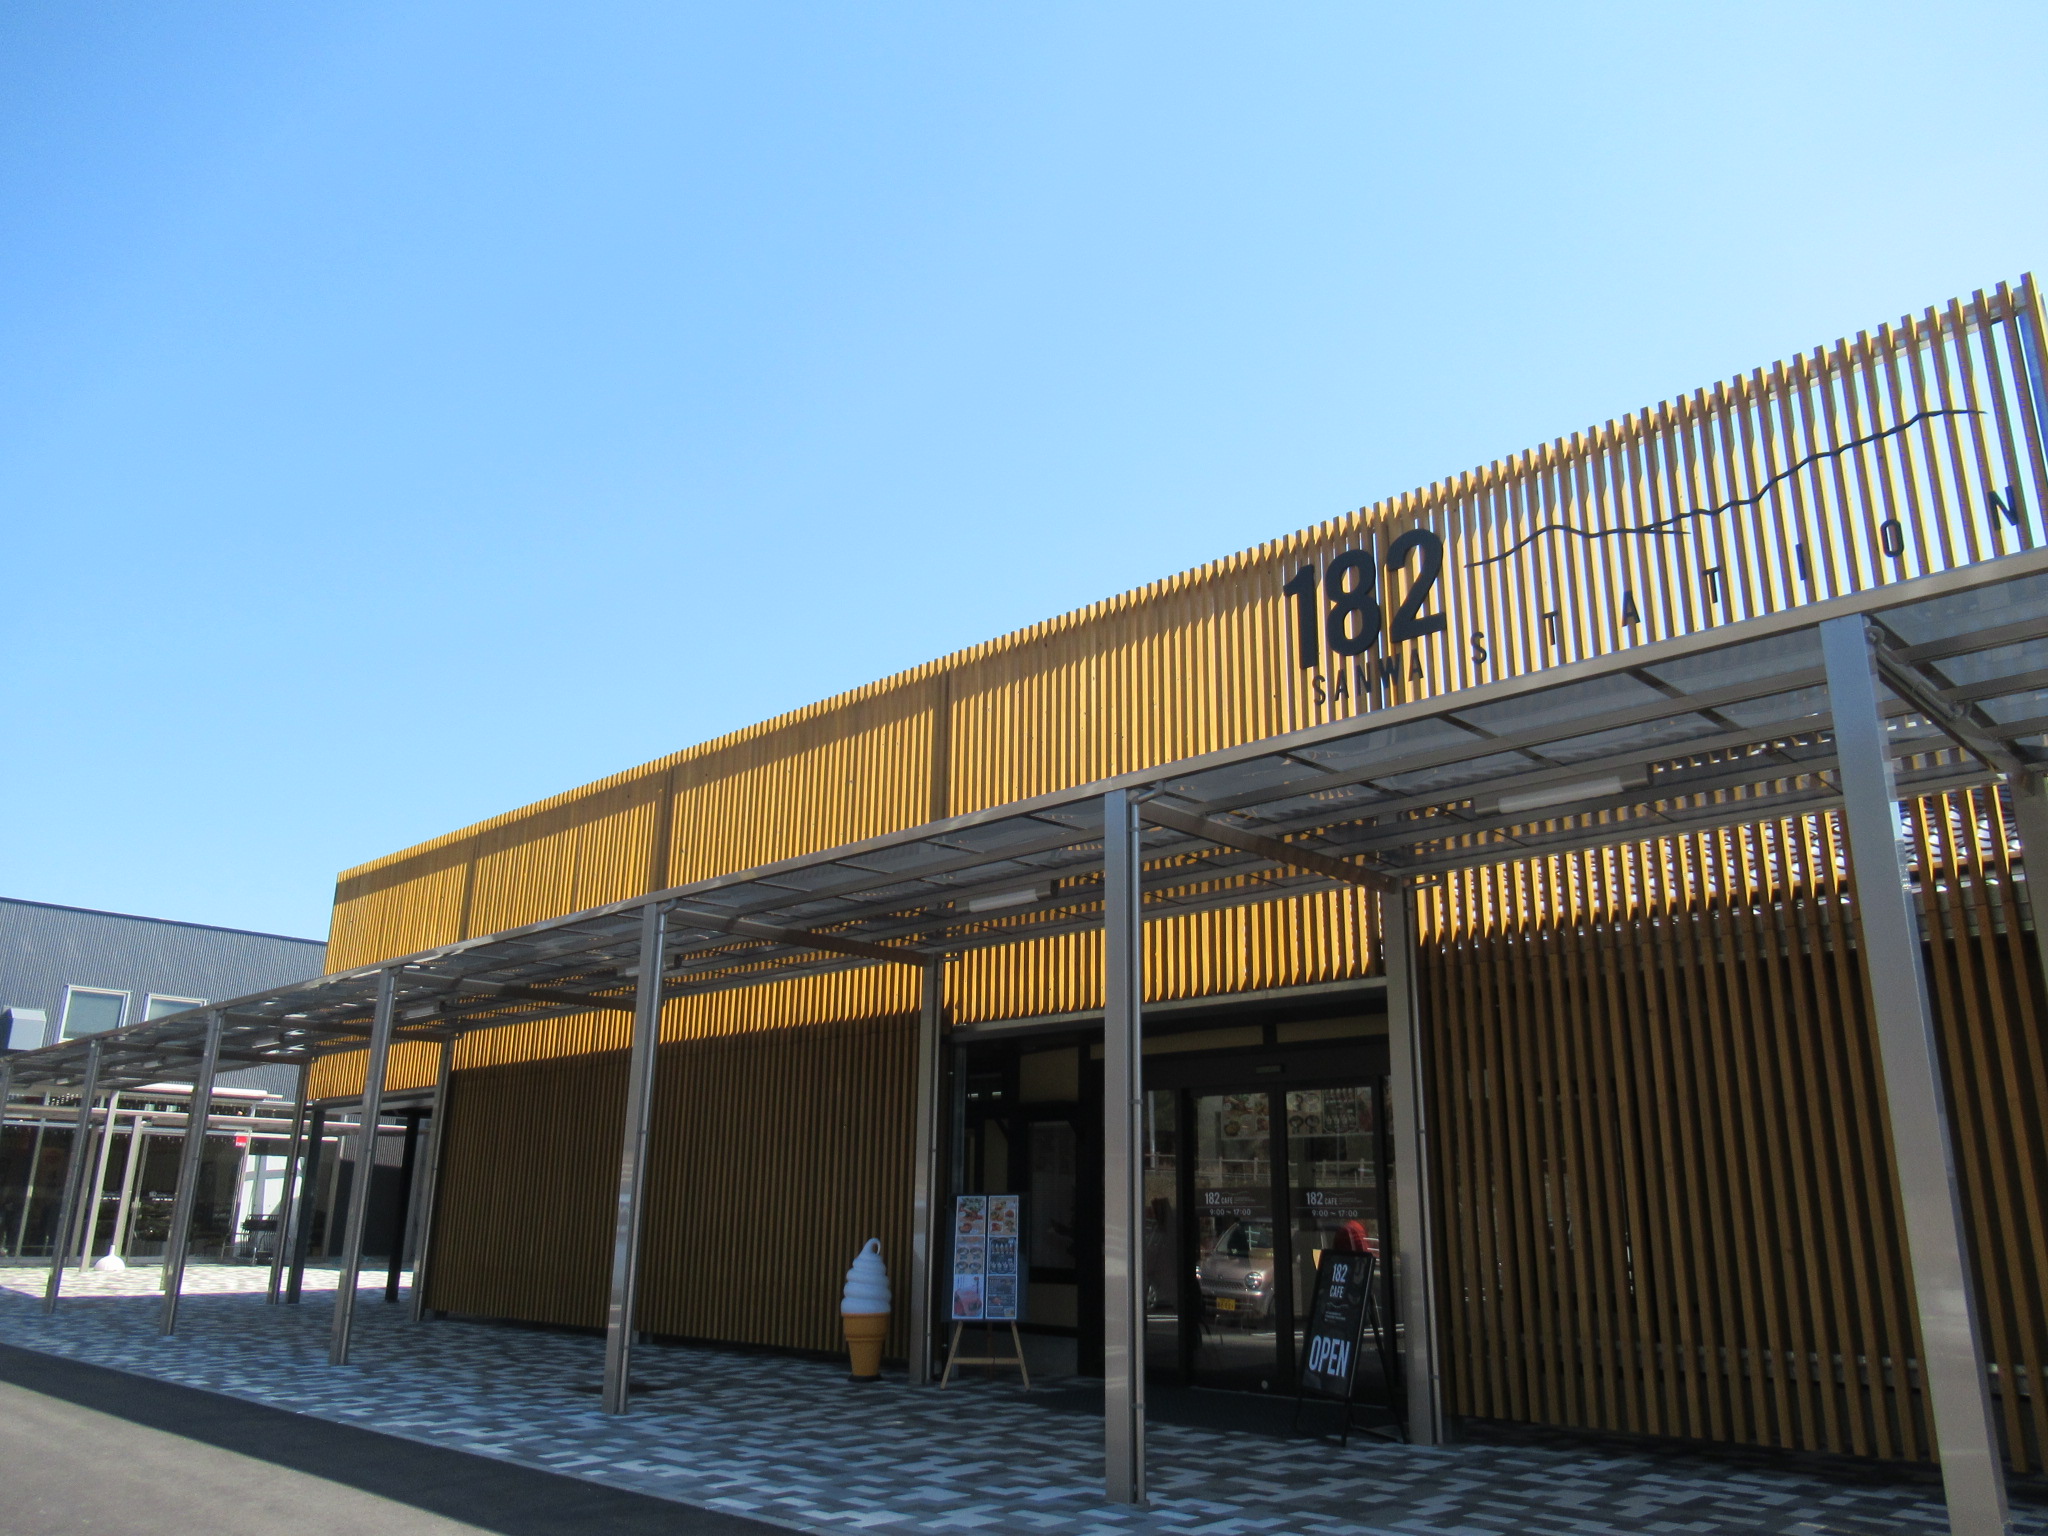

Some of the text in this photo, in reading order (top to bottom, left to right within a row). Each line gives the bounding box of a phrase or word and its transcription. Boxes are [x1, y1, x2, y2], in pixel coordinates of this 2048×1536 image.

[1283, 528, 1447, 669] 182
[1312, 485, 2021, 705] SANWA STATION
[1205, 1192, 1220, 1204] 182
[1306, 1192, 1323, 1205] 182
[1325, 1197, 1338, 1205] CAFE
[1332, 1263, 1348, 1283] 182
[1329, 1285, 1344, 1298] CAFE
[1309, 1335, 1350, 1377] OPEN
